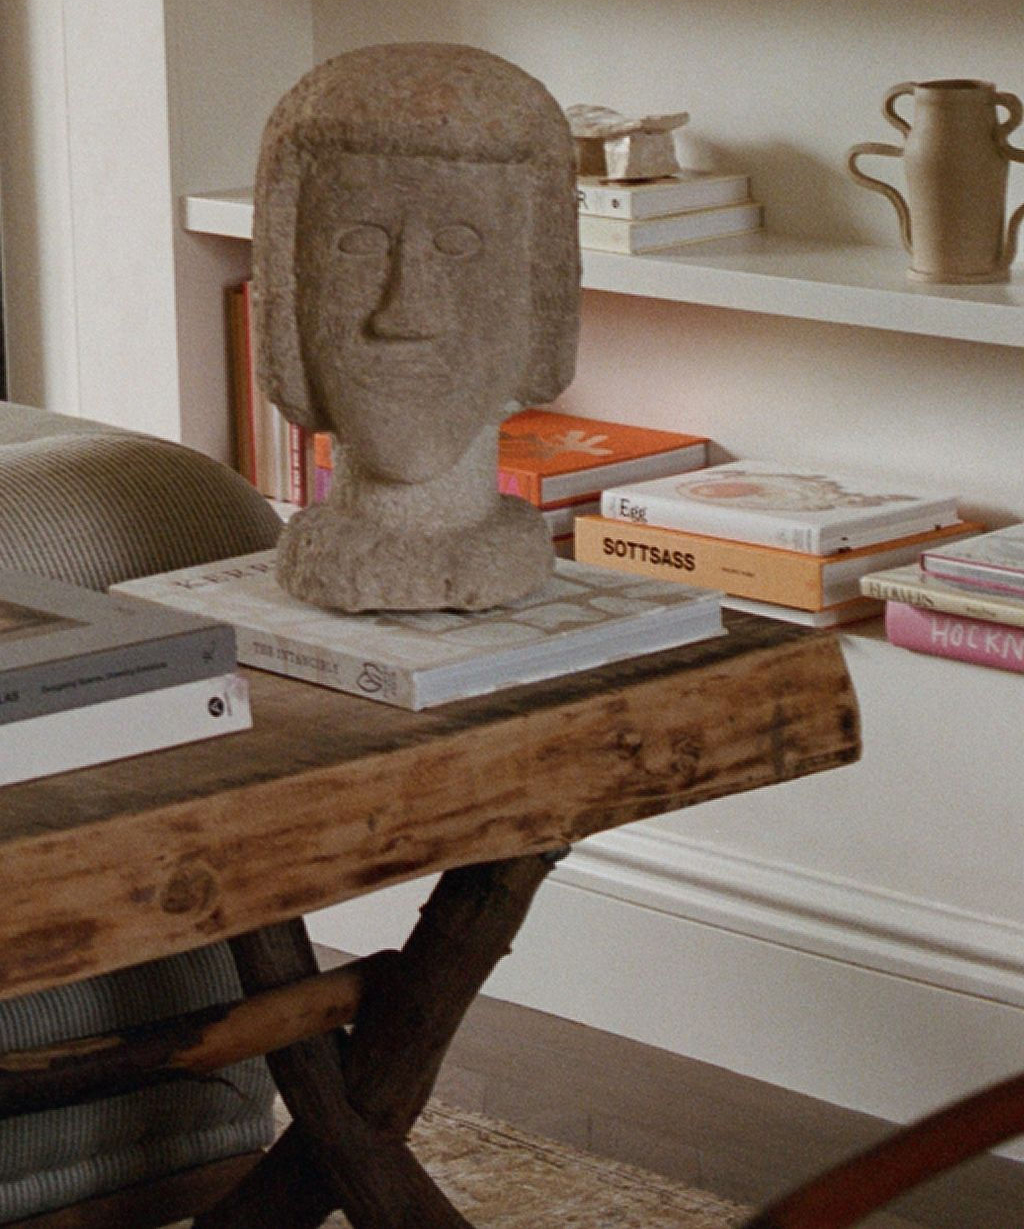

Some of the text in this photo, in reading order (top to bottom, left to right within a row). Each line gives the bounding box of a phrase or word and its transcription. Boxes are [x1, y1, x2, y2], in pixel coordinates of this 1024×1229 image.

[619, 498, 648, 524] Egg
[602, 537, 696, 572] SOTTSASS
[252, 641, 274, 657] THE
